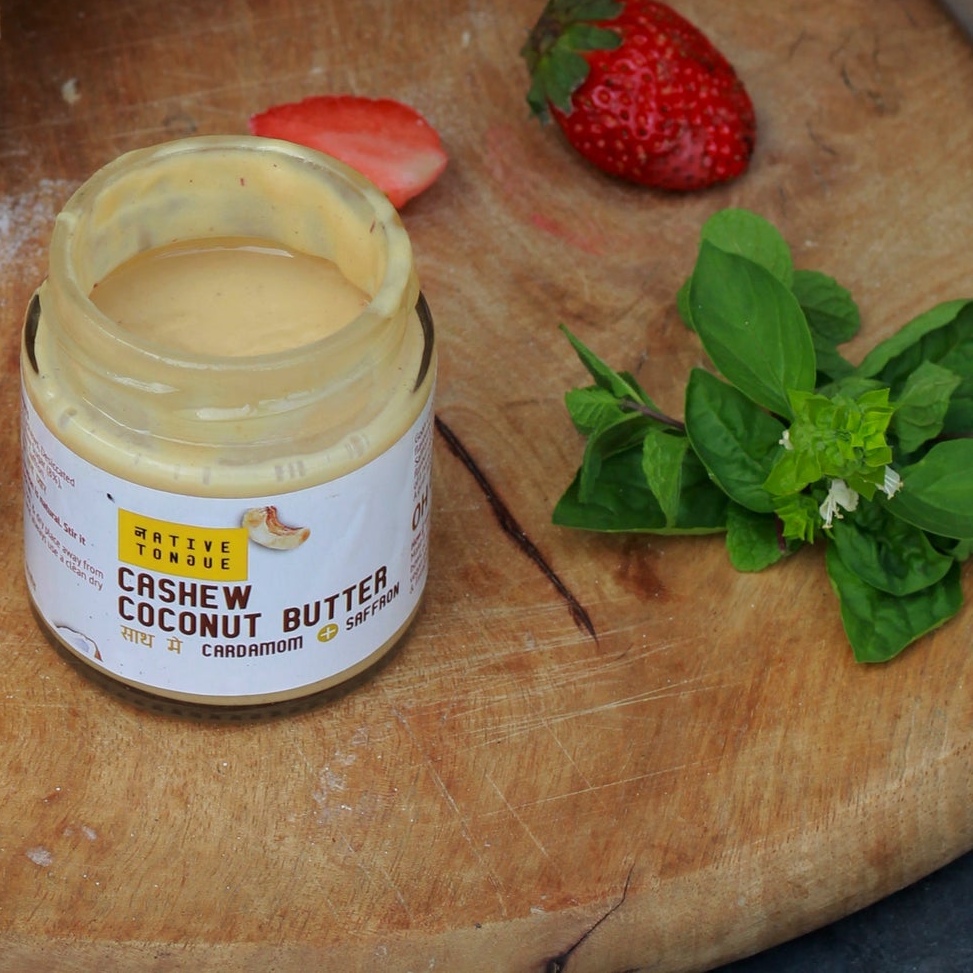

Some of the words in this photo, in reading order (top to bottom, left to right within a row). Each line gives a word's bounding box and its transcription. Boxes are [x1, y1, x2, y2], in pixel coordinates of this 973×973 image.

[63, 522, 78, 540] Stir
[62, 545, 82, 567] away
[83, 560, 104, 579] from
[136, 543, 230, 570] TONGUE
[66, 560, 87, 580] clean
[89, 576, 103, 591] dry
[118, 566, 252, 610] CASHEW
[118, 595, 262, 639] COCONUT
[283, 565, 387, 633] BUTTER
[202, 635, 303, 658] CARDAMOM
[346, 582, 400, 631] SAFFRON
[120, 625, 155, 648] साथ
